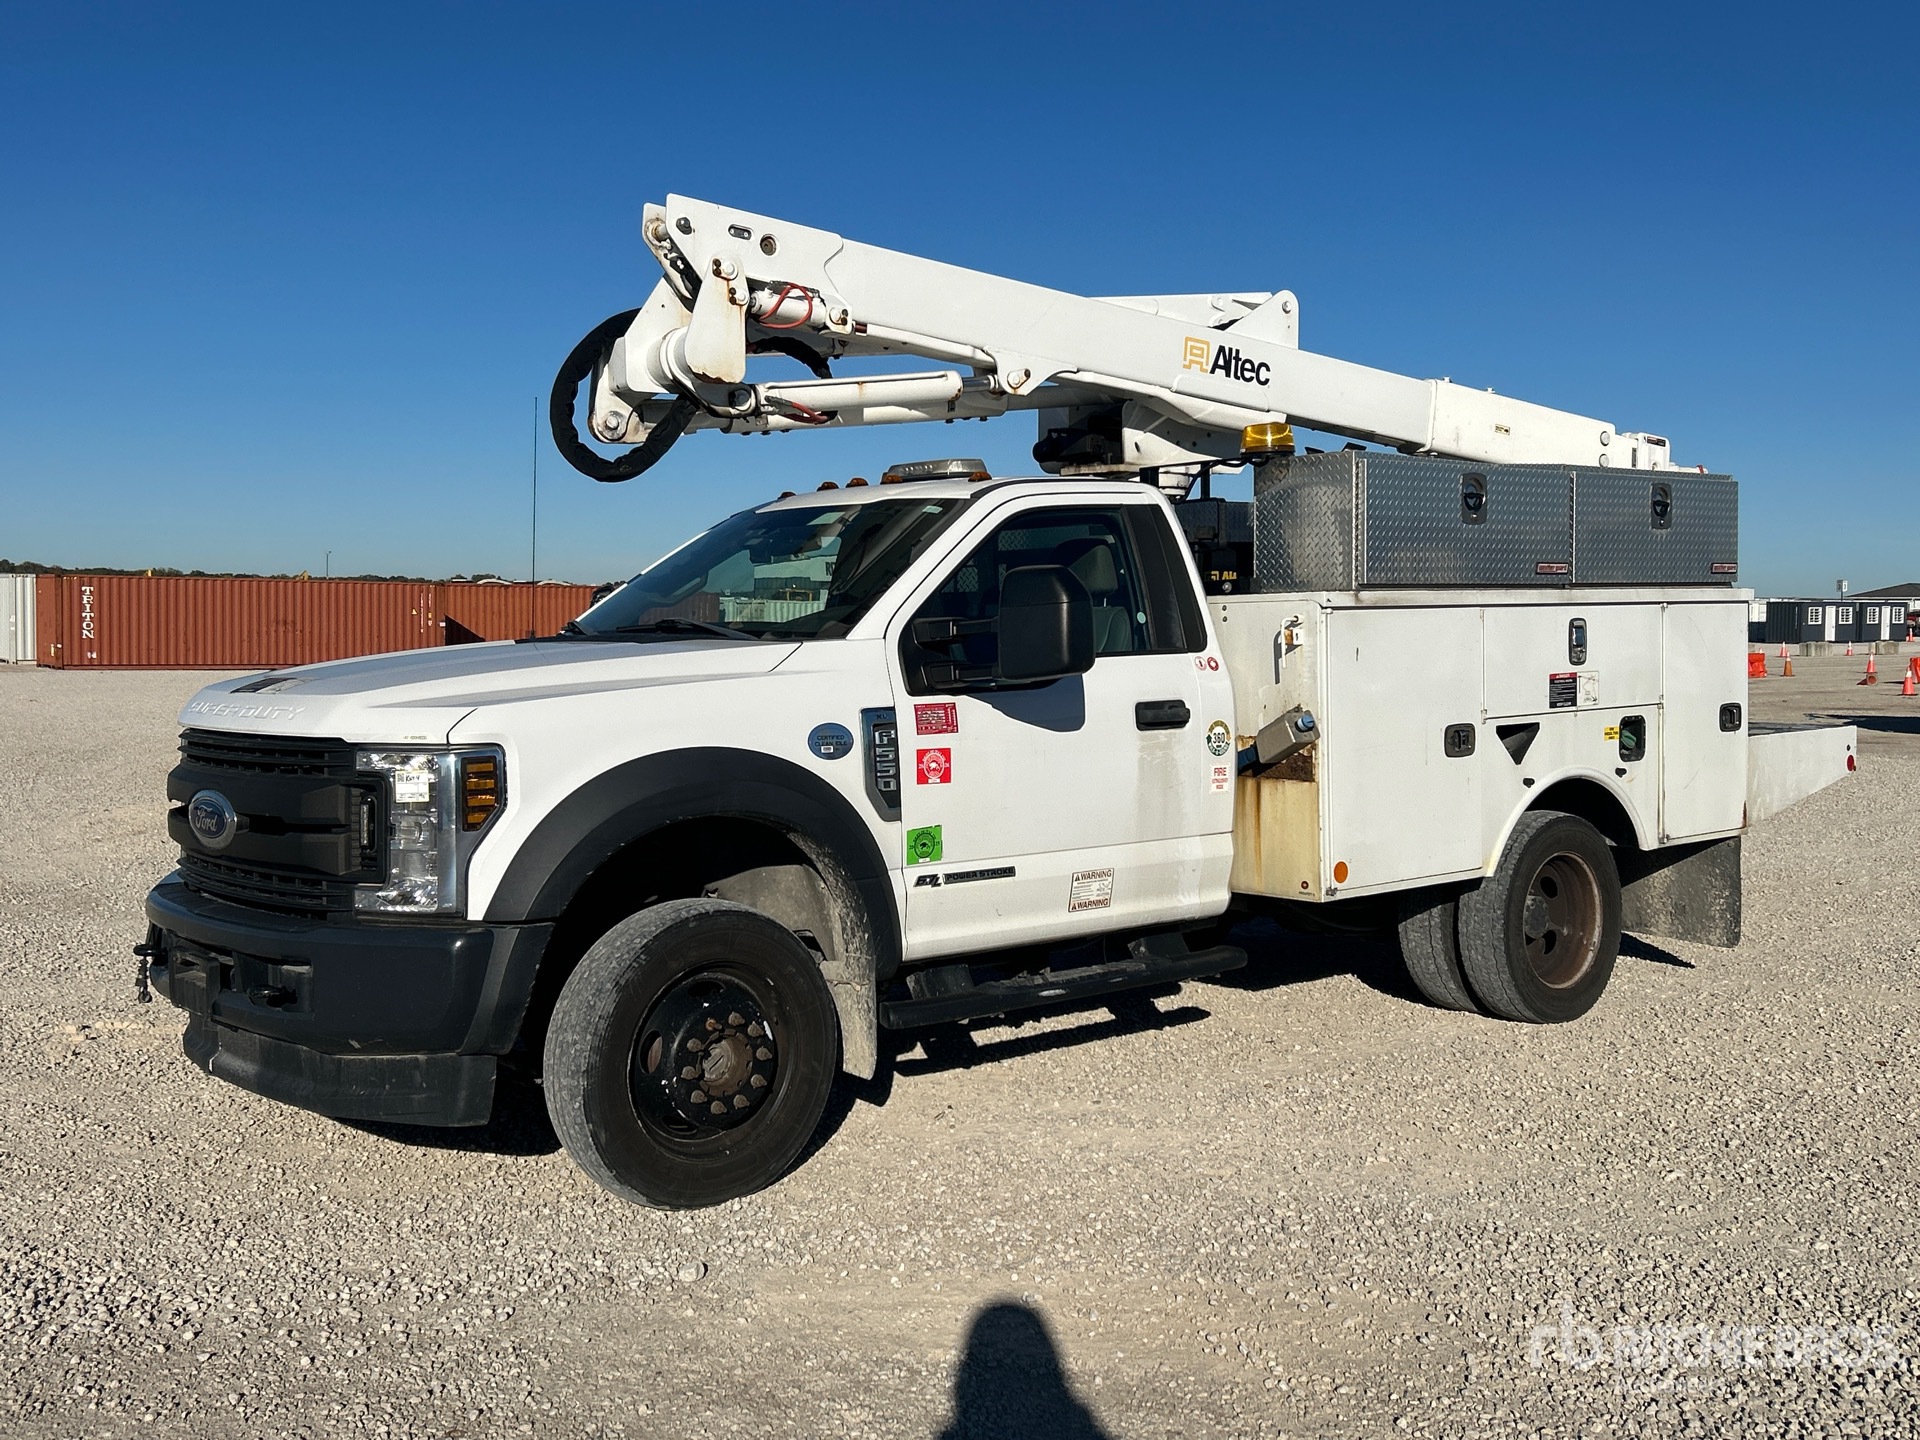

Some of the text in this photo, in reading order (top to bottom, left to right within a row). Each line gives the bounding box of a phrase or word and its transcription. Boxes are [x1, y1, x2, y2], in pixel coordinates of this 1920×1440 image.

[1209, 344, 1271, 386] Altec
[81, 586, 95, 639] TRITON
[187, 701, 306, 721] SUPER DUTY
[1212, 732, 1226, 744] 360
[875, 729, 897, 792] F550
[1213, 767, 1228, 776] FIRE
[195, 804, 219, 832] Ford
[946, 871, 979, 881] POWER
[979, 867, 1015, 878] STROKE
[1080, 869, 1112, 881] WARNING
[1076, 898, 1109, 909] WARNING
